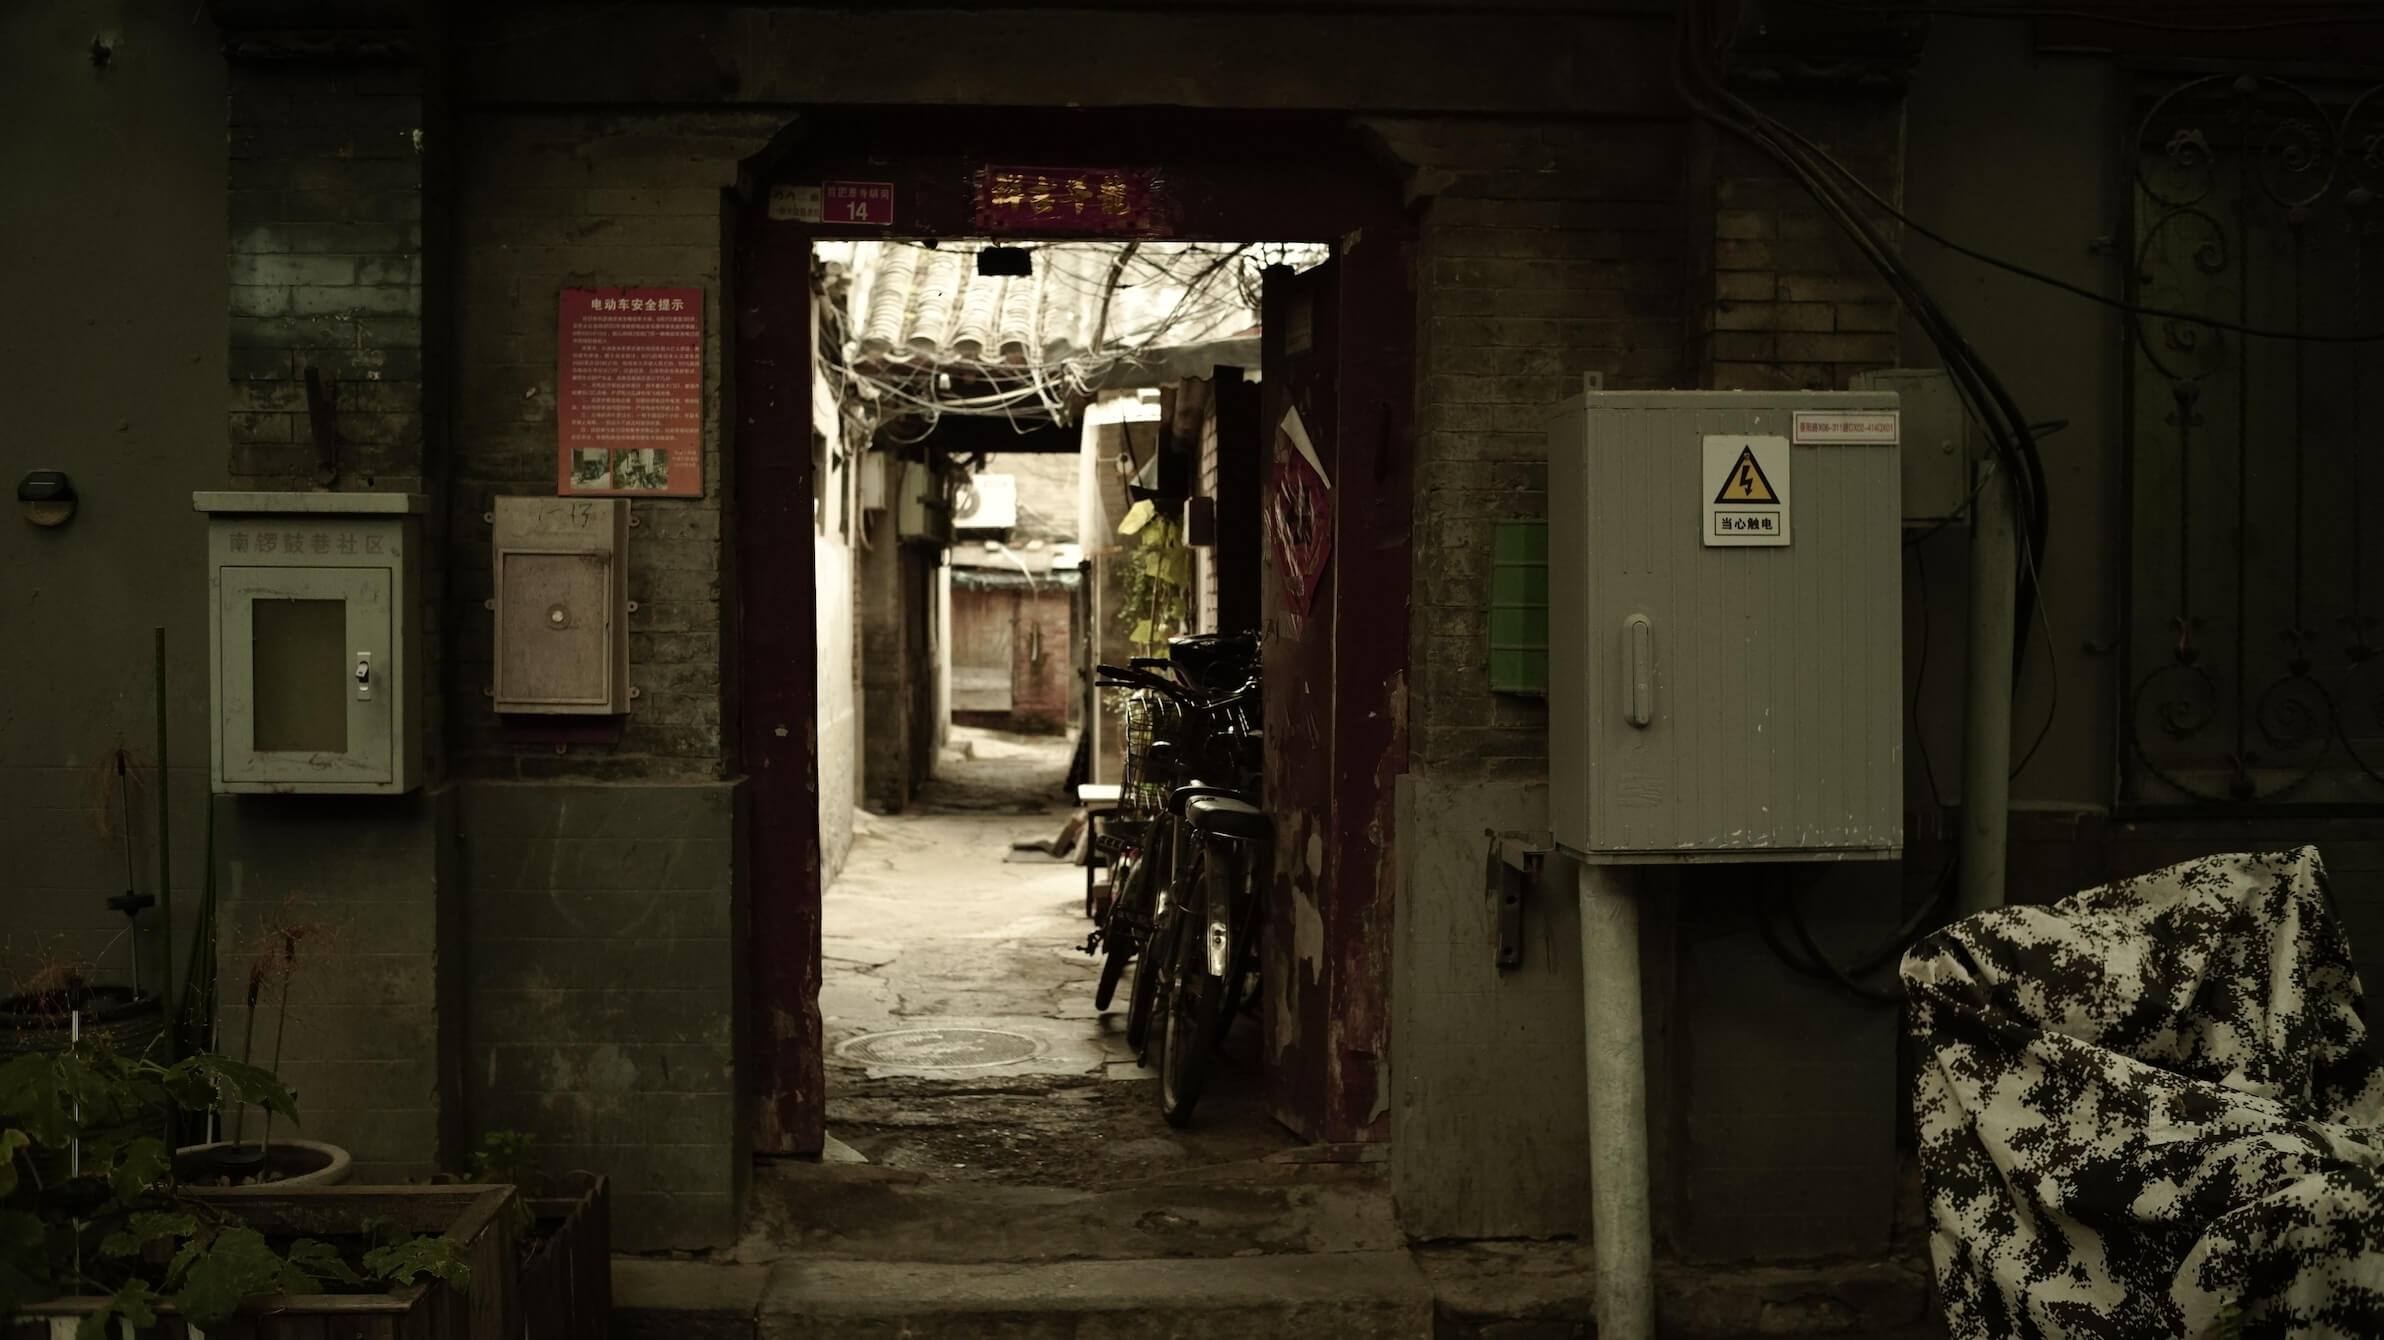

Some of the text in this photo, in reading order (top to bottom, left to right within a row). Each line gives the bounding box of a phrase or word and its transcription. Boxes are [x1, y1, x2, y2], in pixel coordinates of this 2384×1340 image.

[846, 201, 869, 221] 14
[591, 298, 685, 312] 电动车安全提示
[1721, 517, 1773, 530] 当心触电
[229, 532, 385, 555] 南锣鼓巷社区
